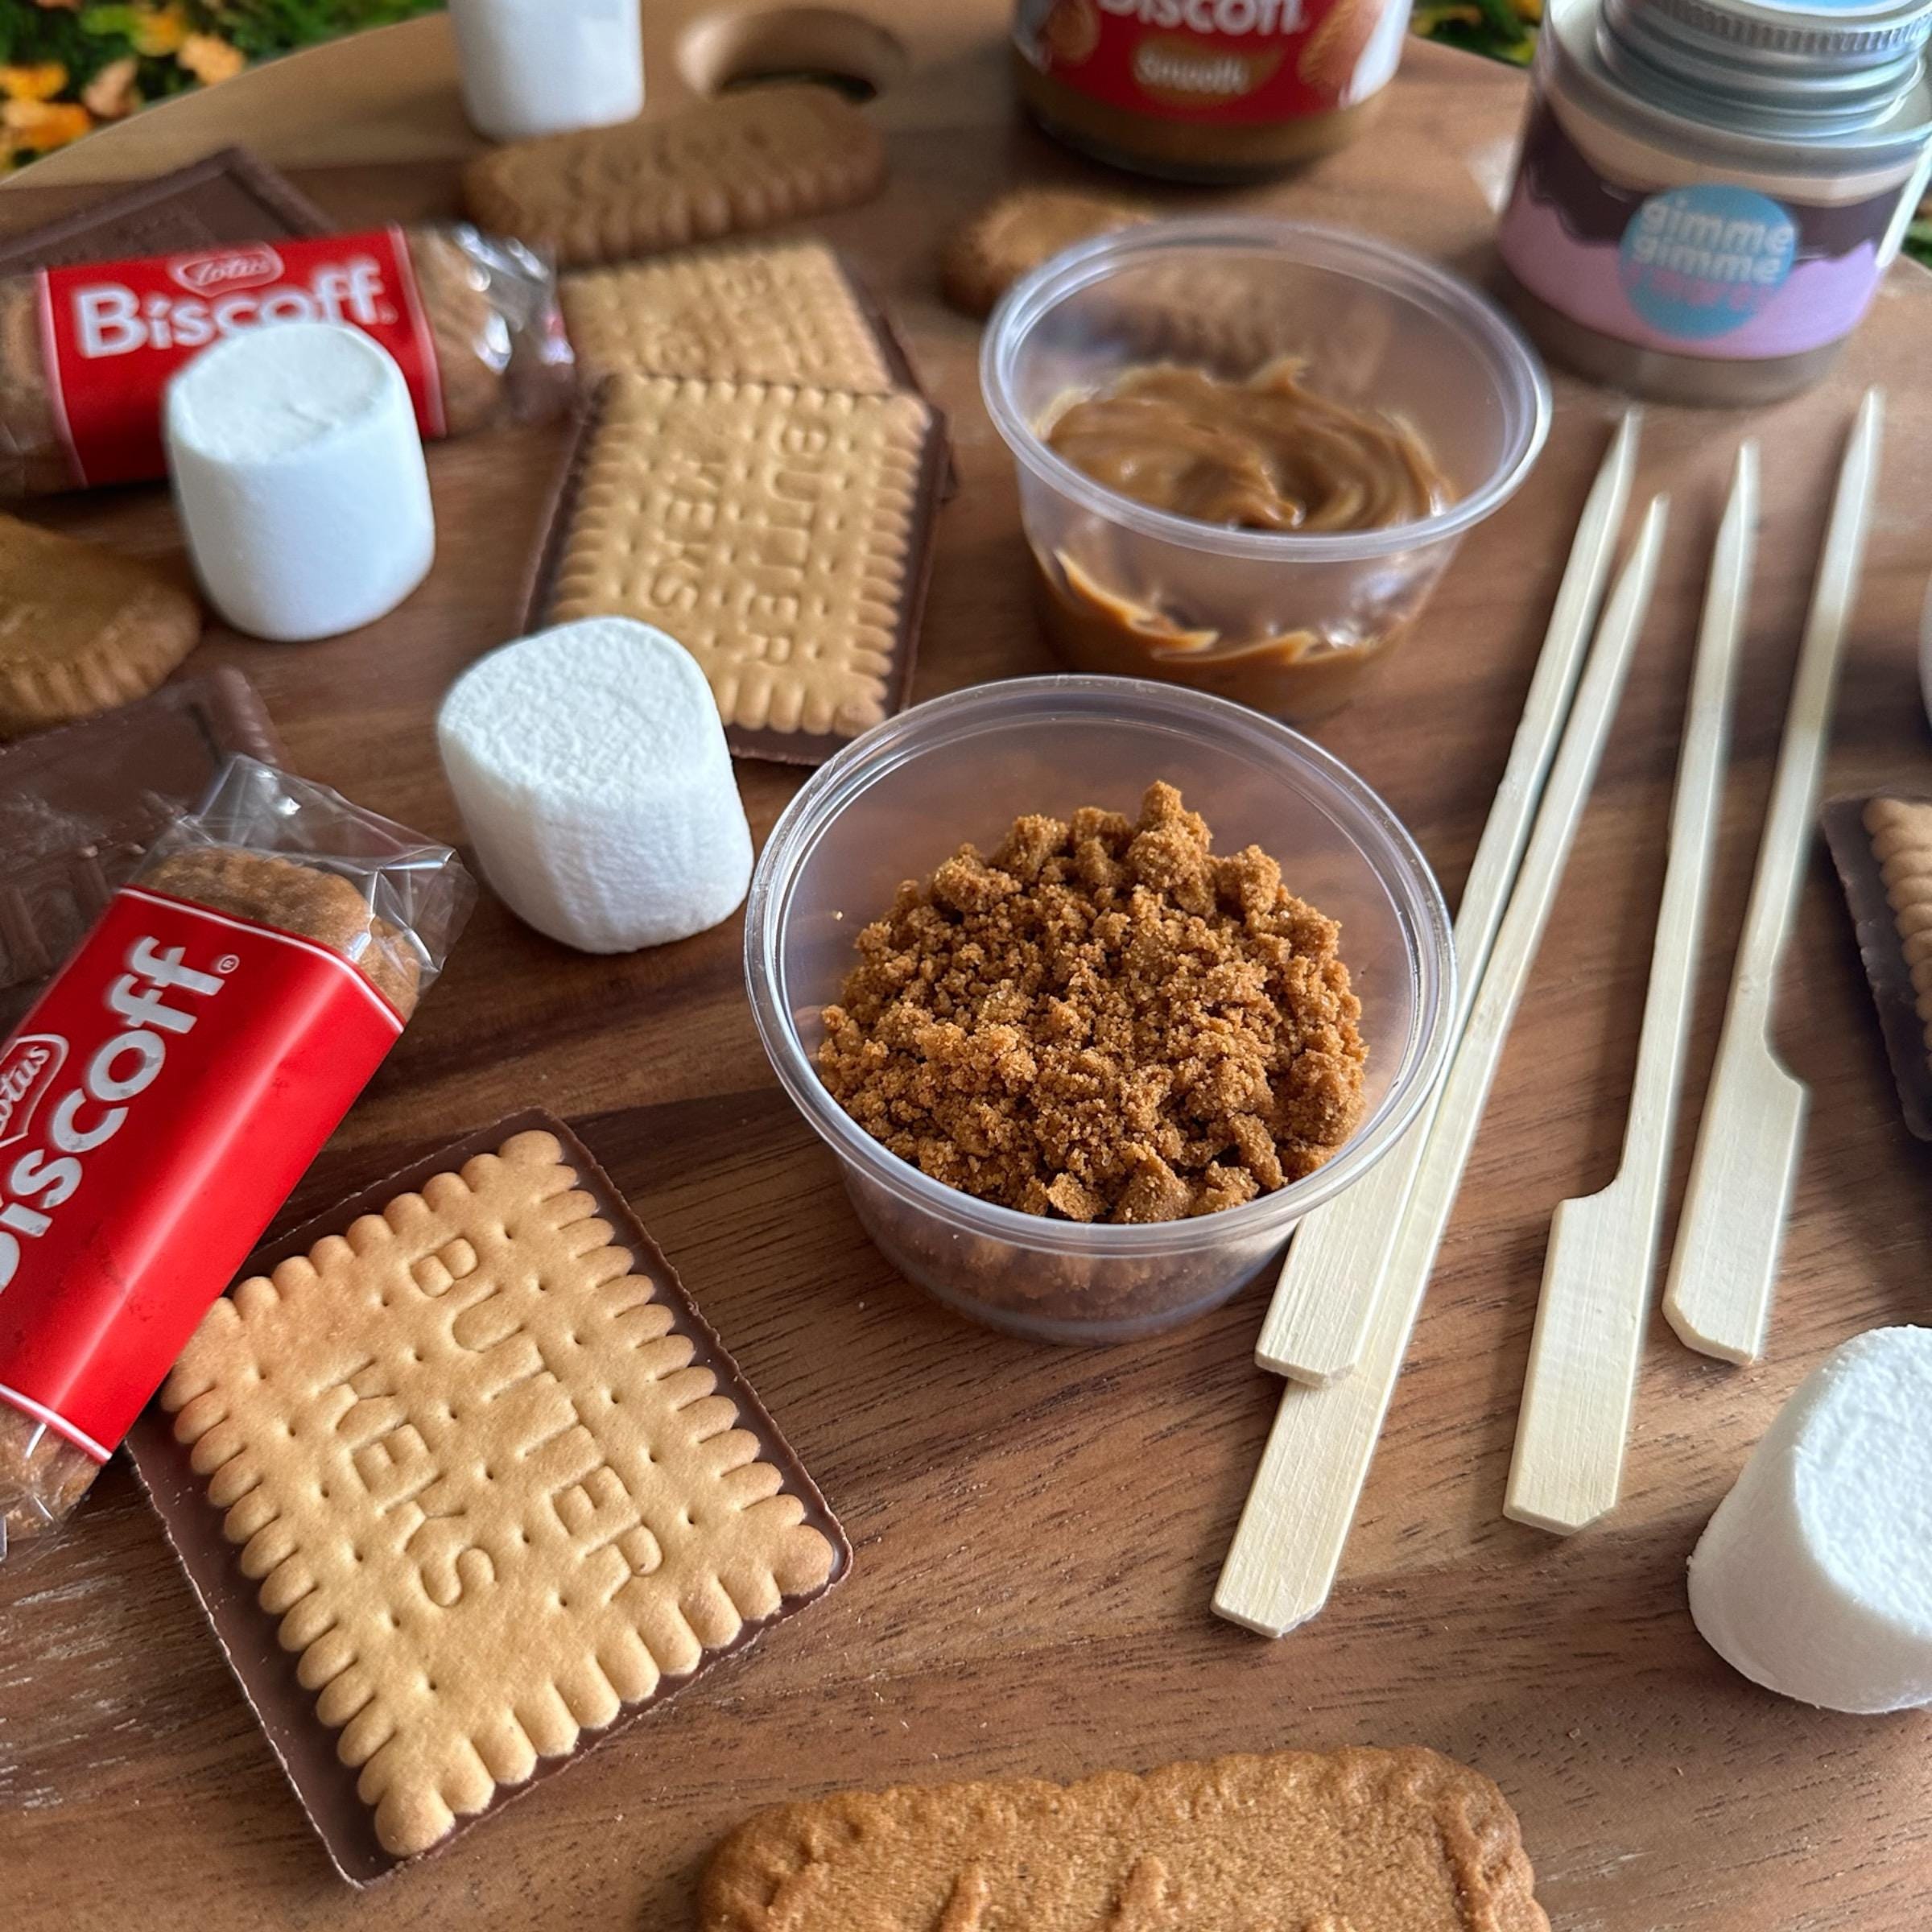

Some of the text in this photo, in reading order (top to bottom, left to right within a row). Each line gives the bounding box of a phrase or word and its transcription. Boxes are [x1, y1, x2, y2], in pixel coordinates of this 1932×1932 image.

[1098, 0, 1304, 35] isco
[196, 254, 271, 287] Lotus
[1633, 236, 1781, 285] gimme
[1640, 199, 1795, 255] gimme
[74, 254, 383, 359] Biscoff
[0, 1046, 50, 1137] otus
[0, 936, 225, 1294] iscoff
[409, 1236, 663, 1604] BUTTER
[319, 1359, 496, 1608] KEKS
